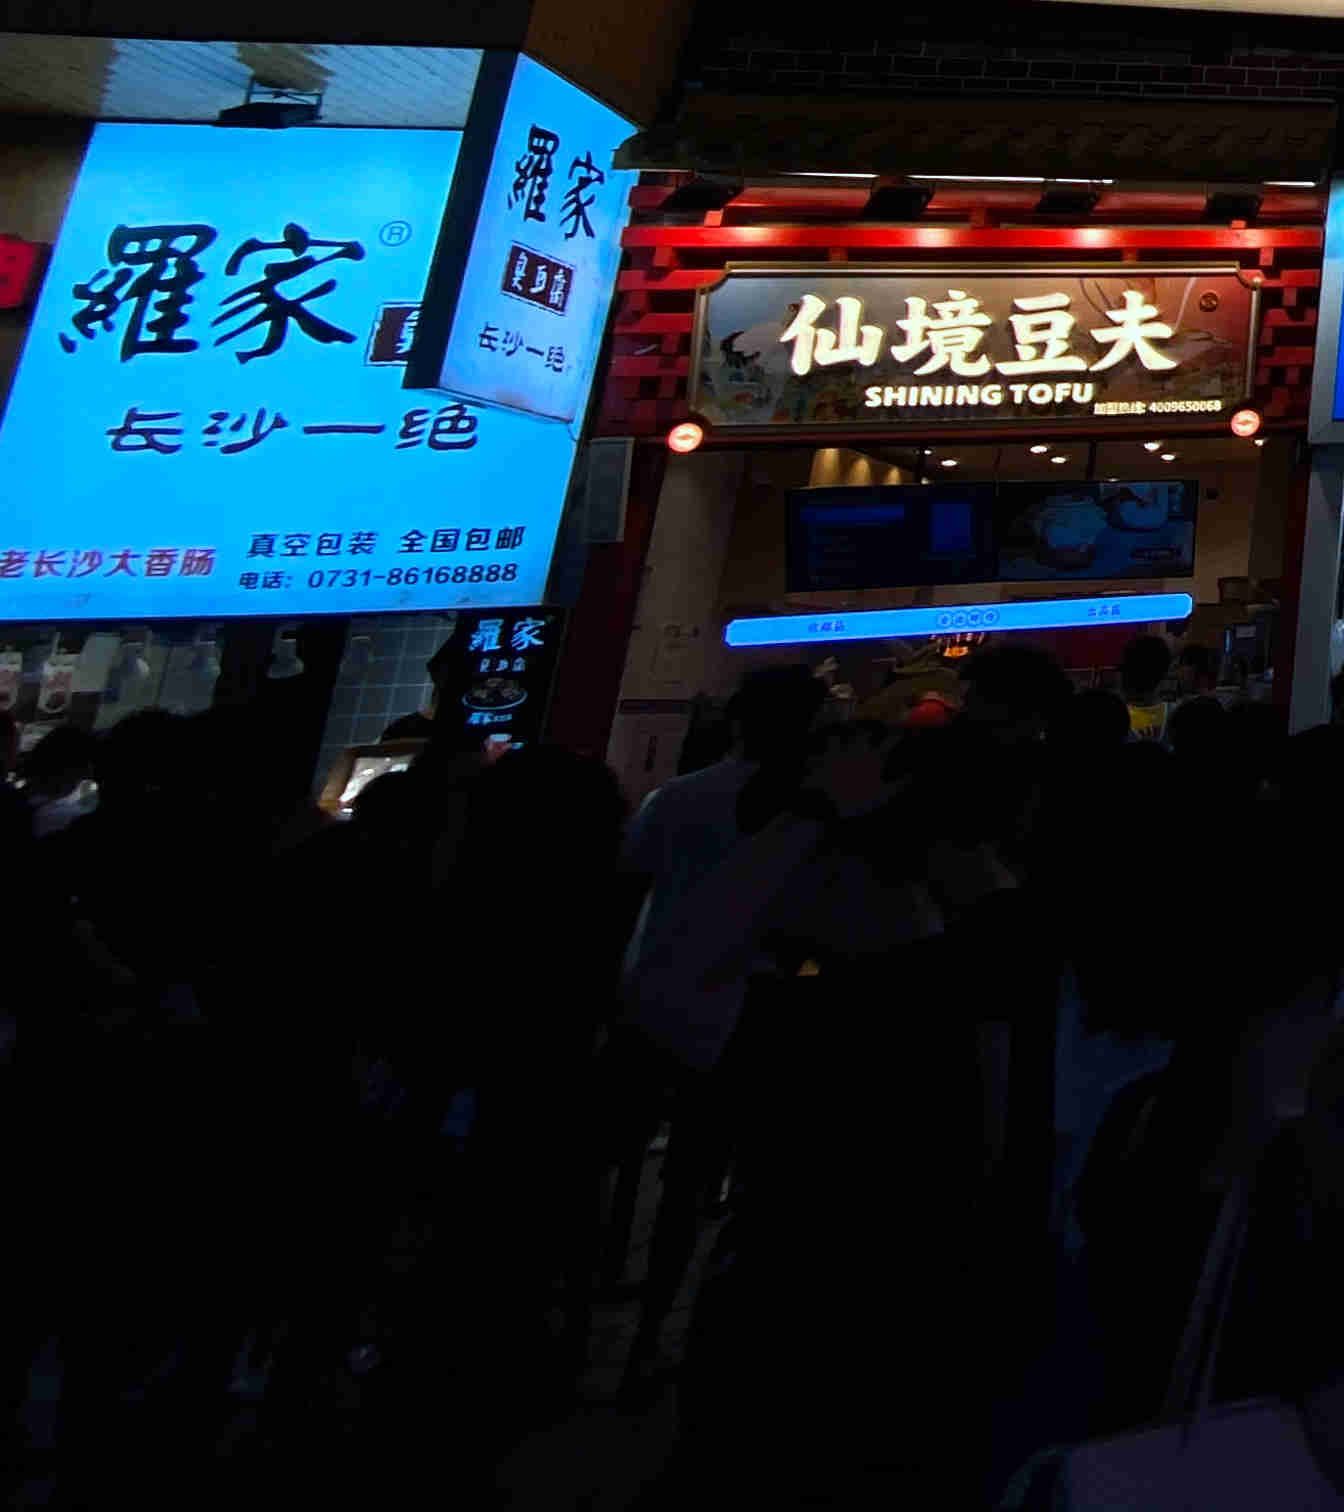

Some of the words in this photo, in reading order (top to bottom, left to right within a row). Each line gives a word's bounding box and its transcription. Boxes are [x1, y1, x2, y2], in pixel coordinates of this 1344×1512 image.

[58, 220, 367, 366] 羅家
[779, 288, 1180, 378] 仙境豆夫
[863, 383, 1004, 409] SHINING
[1009, 382, 1095, 405] TOFU
[104, 402, 482, 456] 长沙一绝
[246, 530, 378, 559] 真空包装
[399, 525, 526, 555] 全国包邮
[0, 547, 217, 580] 老长沙大香肠
[307, 561, 519, 589] 0731-86168888
